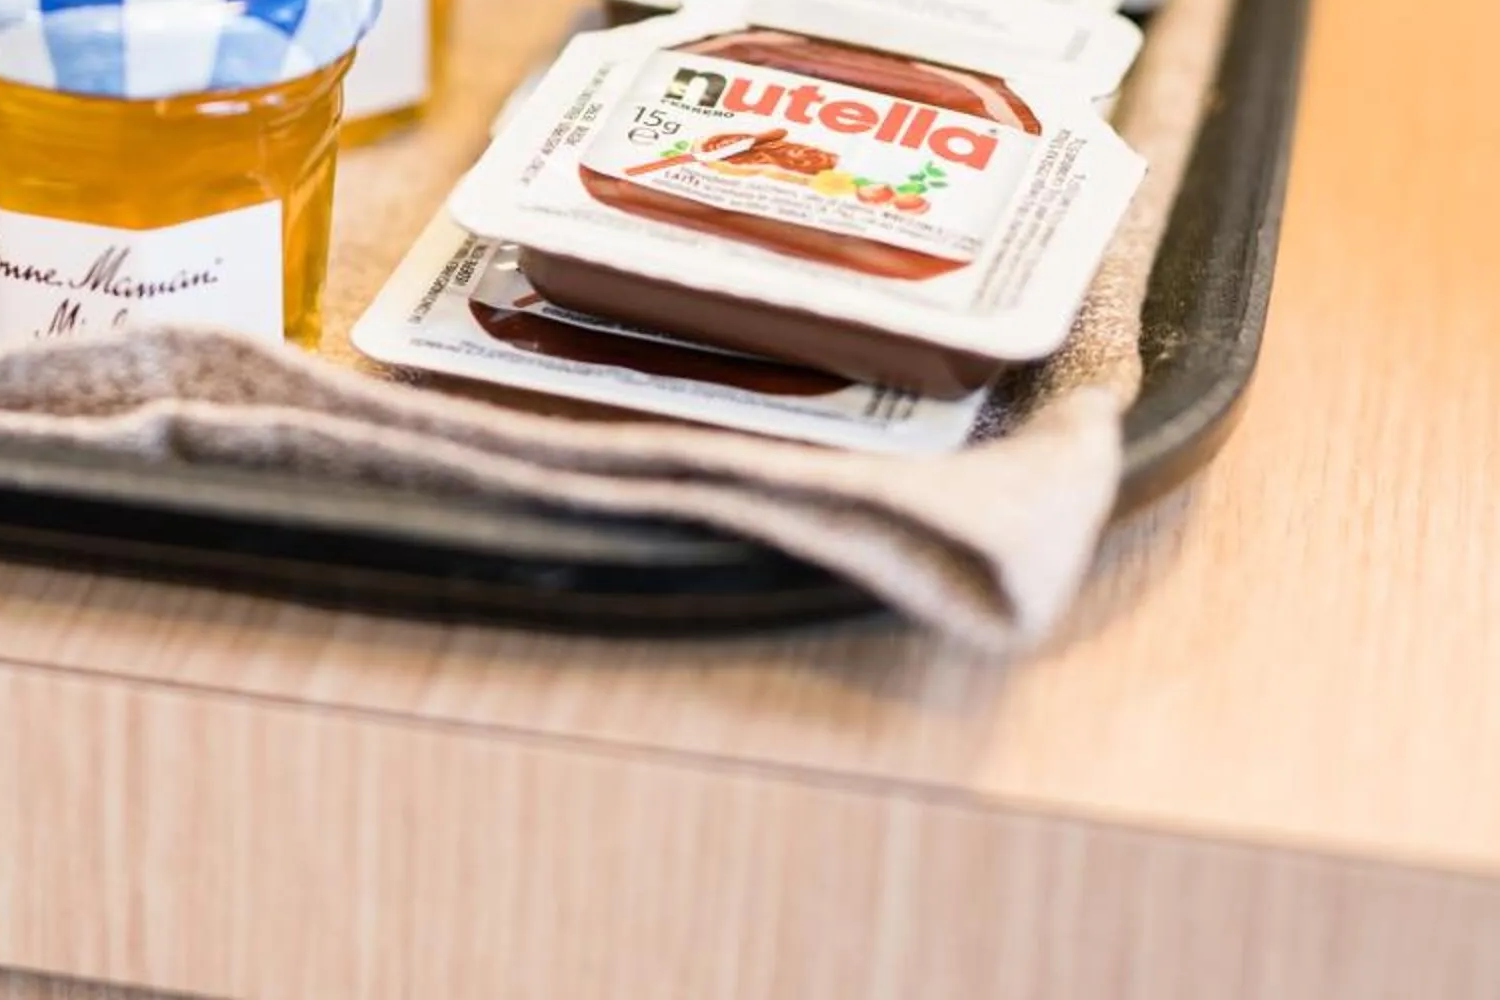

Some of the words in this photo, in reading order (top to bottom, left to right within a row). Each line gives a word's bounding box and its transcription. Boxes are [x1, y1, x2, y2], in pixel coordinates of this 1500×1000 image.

[634, 105, 682, 136] 15g
[664, 68, 998, 172] nutella
[68, 244, 218, 298] Maman
